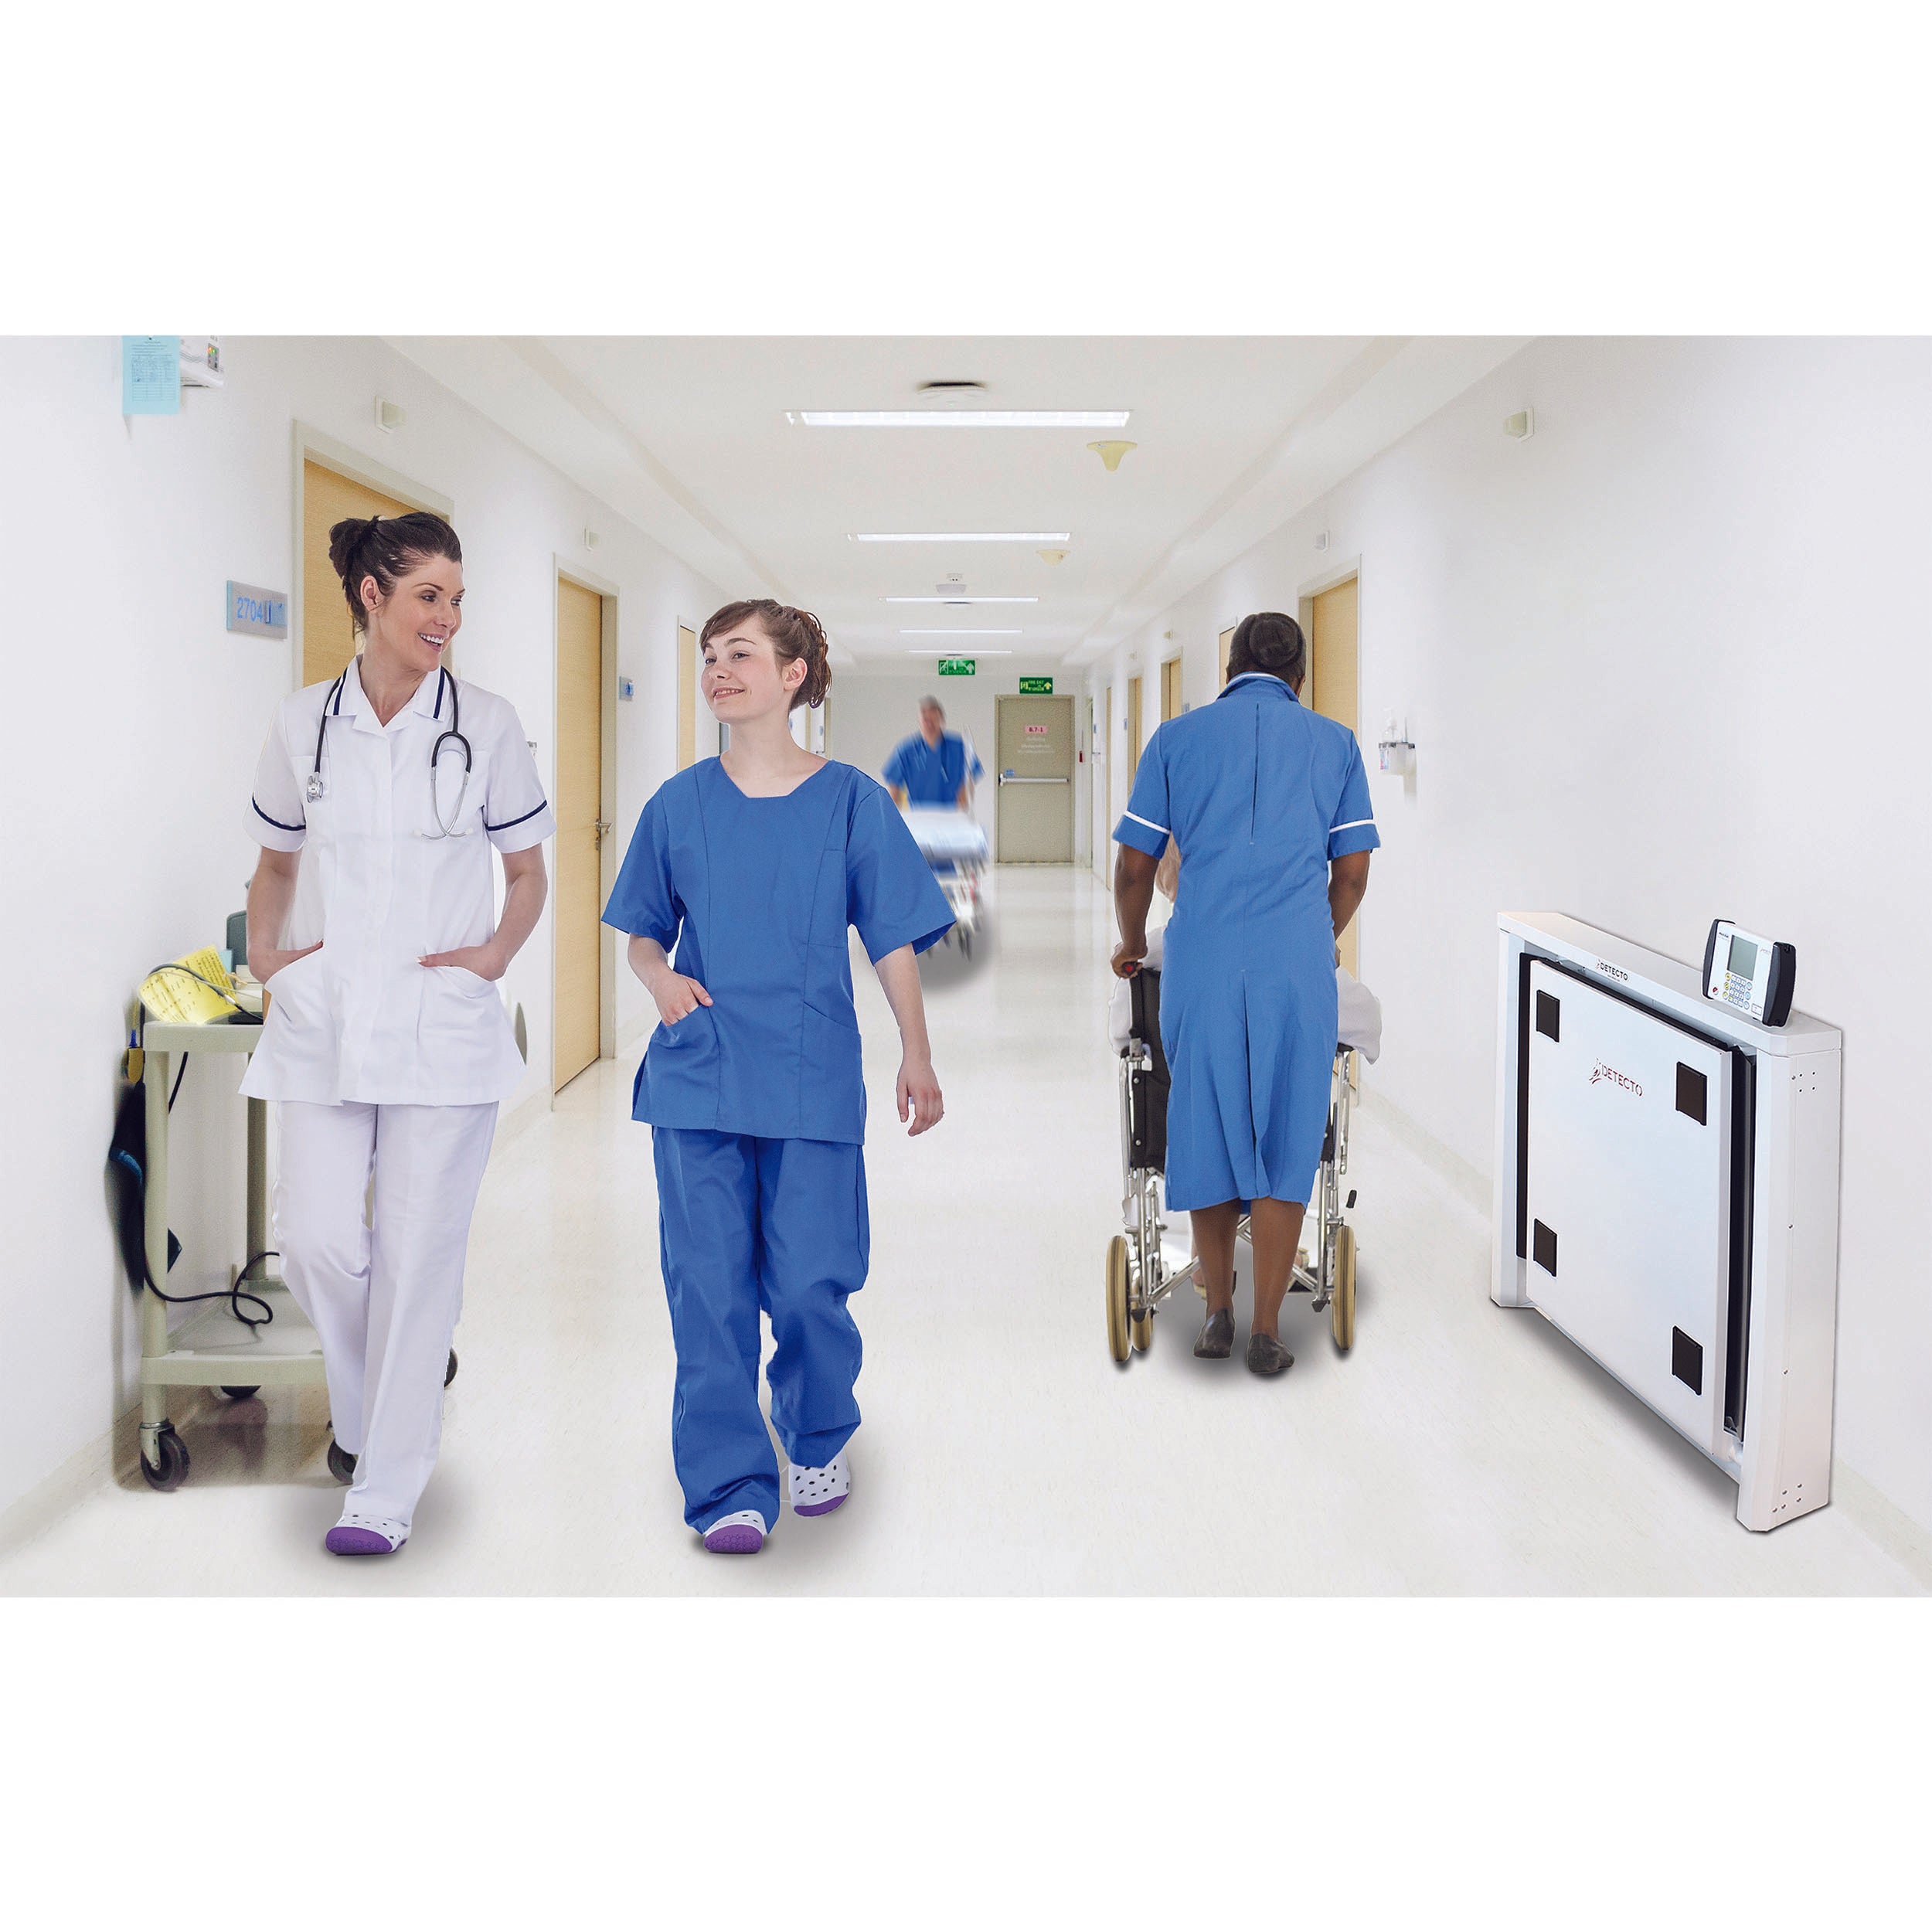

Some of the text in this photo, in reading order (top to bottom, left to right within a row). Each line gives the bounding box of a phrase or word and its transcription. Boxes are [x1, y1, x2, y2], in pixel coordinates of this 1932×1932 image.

[236, 596, 264, 623] 2704
[1600, 962, 1628, 981] DETECTO
[1601, 1064, 1643, 1097] DETECTO
